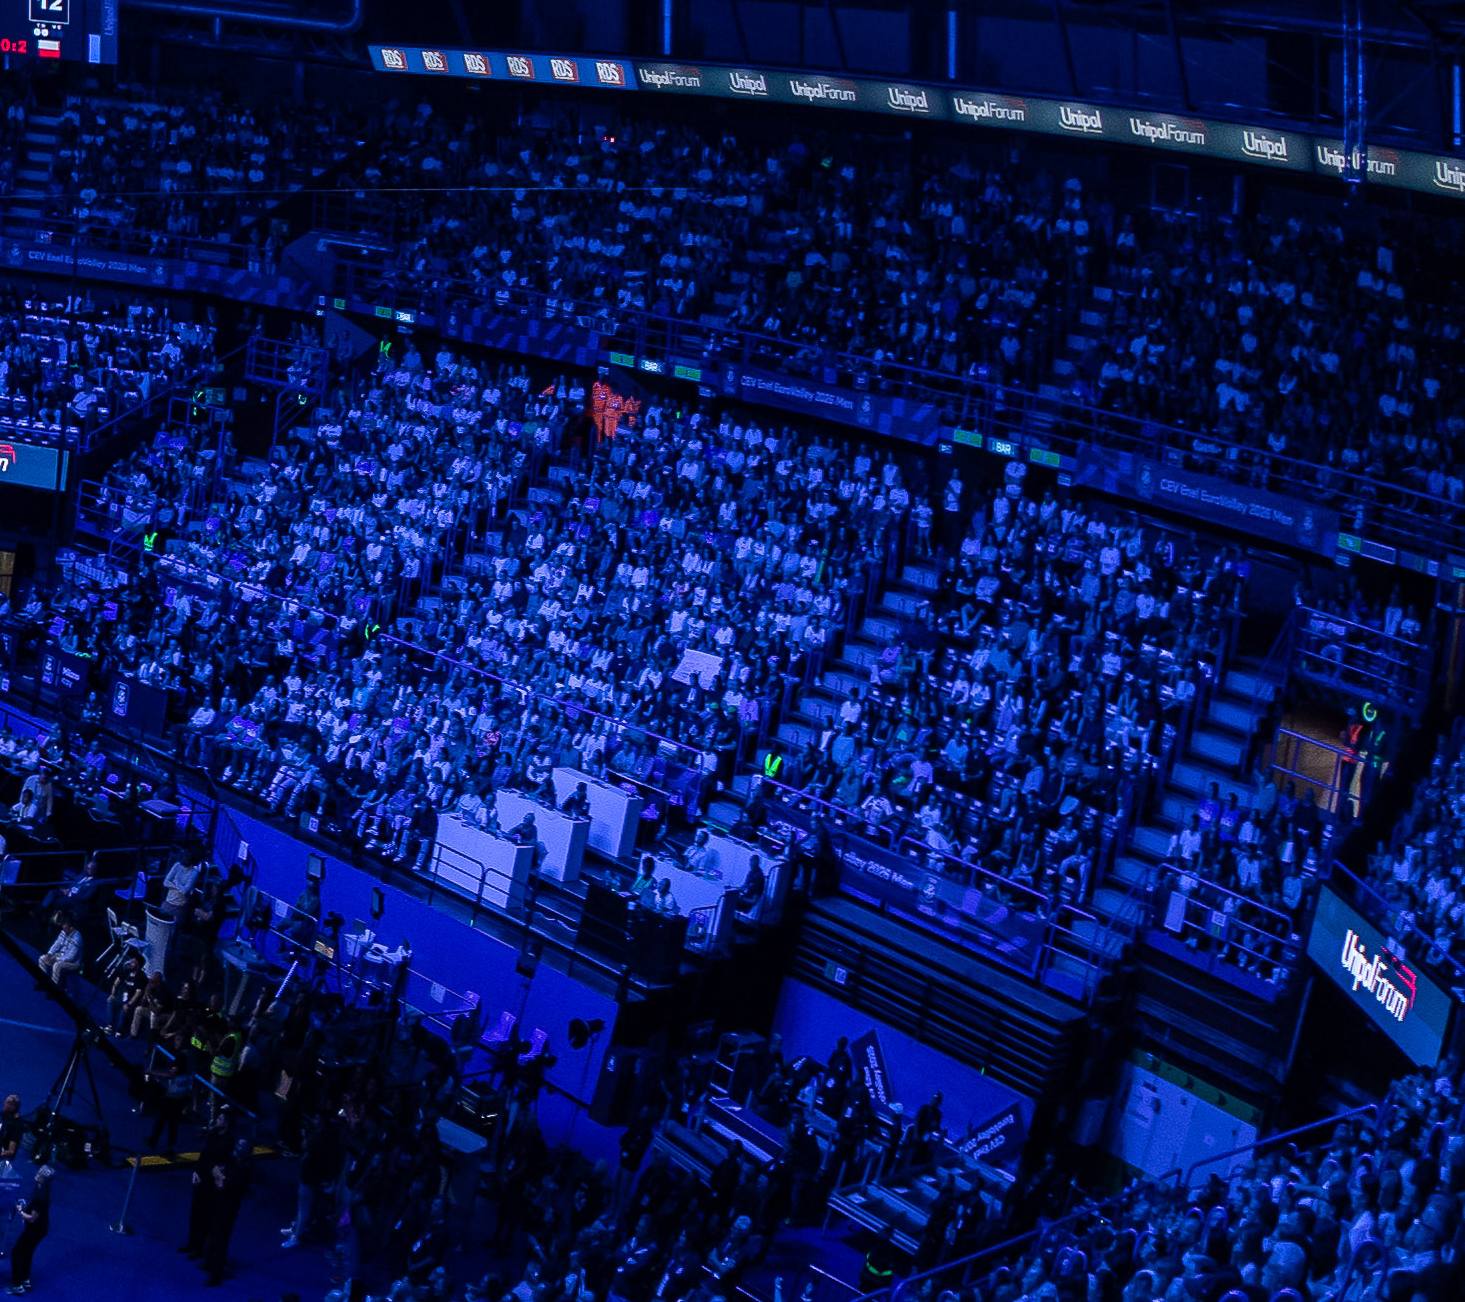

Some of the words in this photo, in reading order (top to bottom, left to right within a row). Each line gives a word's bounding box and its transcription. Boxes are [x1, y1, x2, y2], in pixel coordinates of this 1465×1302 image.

[0, 38, 27, 54] 0:2
[382, 49, 403, 68] RDS
[463, 54, 486, 74] RDS
[596, 62, 620, 84] RDS
[639, 69, 701, 89] UnipolForum
[732, 72, 767, 94] Unipol
[1060, 107, 1102, 132] Unipol
[1131, 118, 1205, 145] UnipolForum
[1244, 131, 1287, 158] Unipol
[1341, 929, 1409, 1021] UnipolForum
